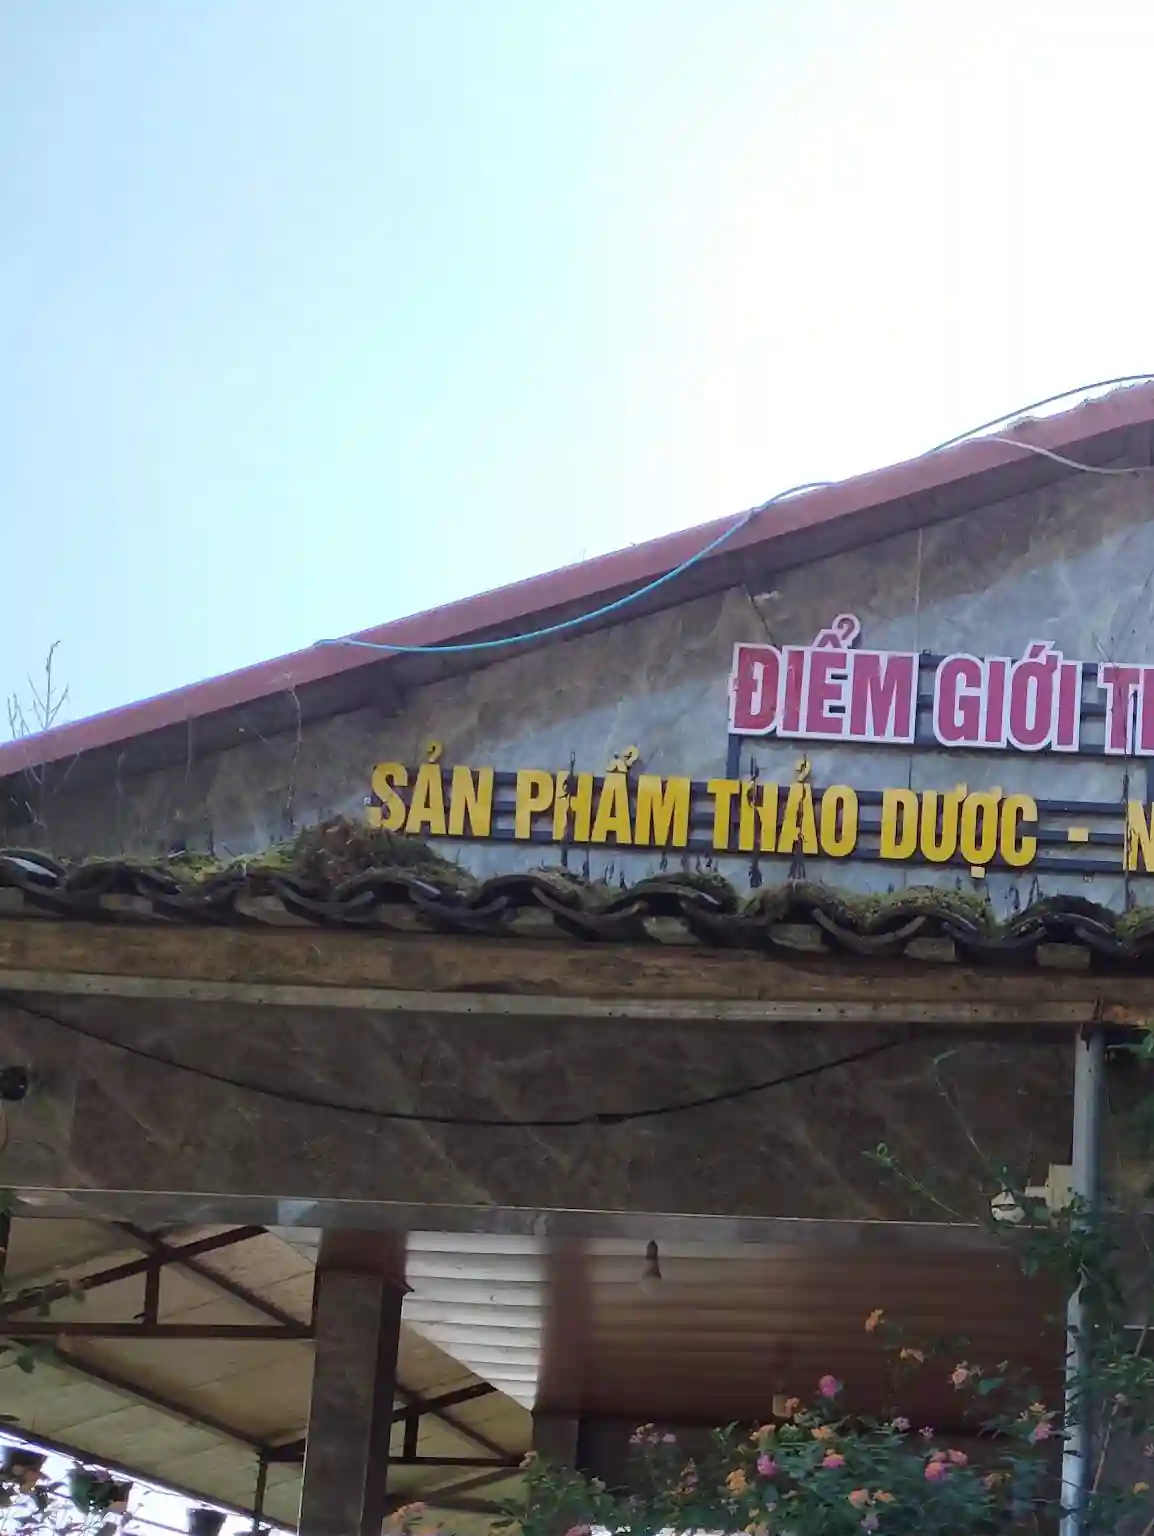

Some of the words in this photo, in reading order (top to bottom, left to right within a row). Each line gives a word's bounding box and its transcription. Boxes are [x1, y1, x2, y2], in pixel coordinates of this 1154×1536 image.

[730, 614, 917, 744] ĐIỂM
[932, 640, 1082, 752] GIỚI
[368, 740, 494, 837] SẢN
[515, 745, 691, 848] PHẨM
[707, 758, 861, 858] THẢO
[878, 781, 1038, 878] DƯỢC
[1067, 827, 1089, 842] -
